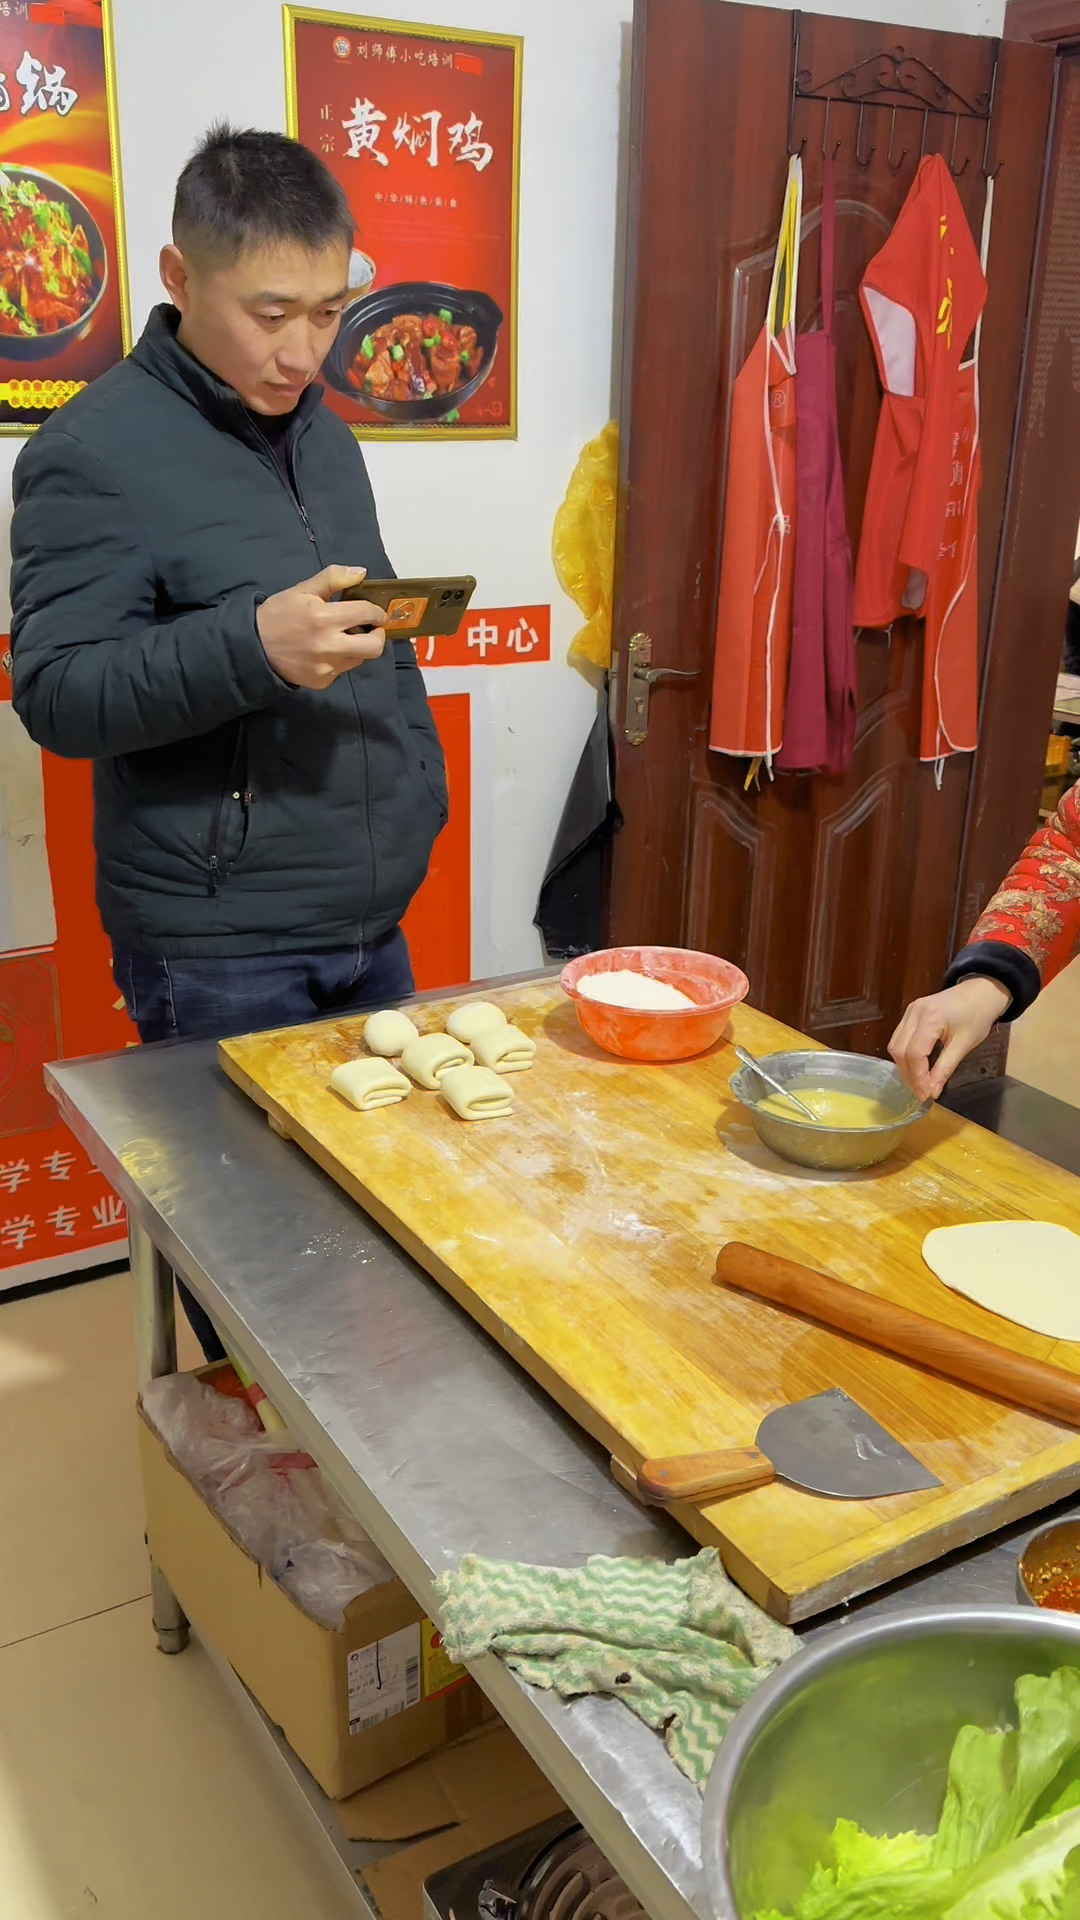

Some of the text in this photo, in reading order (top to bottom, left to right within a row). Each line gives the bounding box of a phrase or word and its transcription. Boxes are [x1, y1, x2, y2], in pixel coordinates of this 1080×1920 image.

[356, 41, 454, 70] 刘师傅小吃培训
[320, 104, 335, 153] 正宗
[341, 97, 494, 172] 黄焖鸡
[0, 1194, 128, 1250] 学专业
